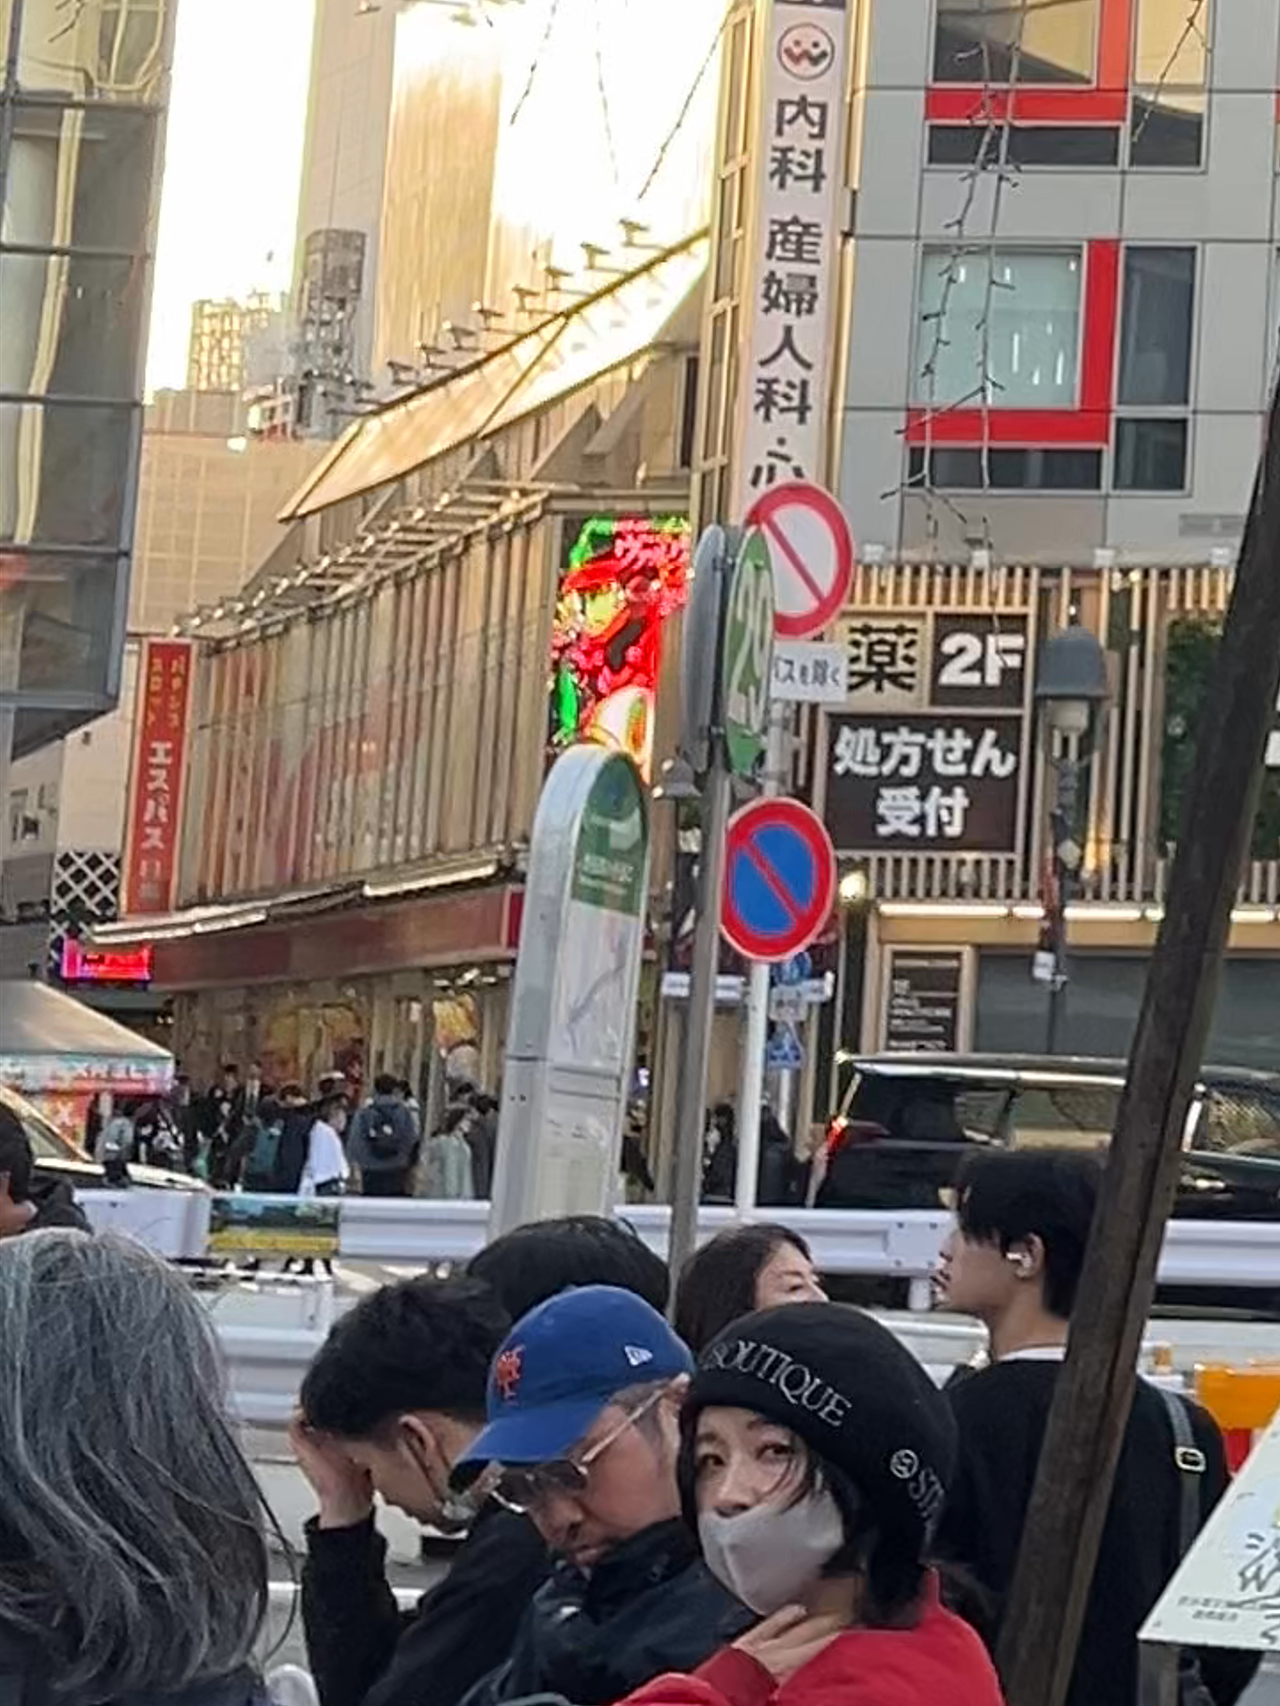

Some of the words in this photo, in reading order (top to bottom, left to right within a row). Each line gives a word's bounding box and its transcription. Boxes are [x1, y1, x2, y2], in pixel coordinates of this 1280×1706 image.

[768, 93, 829, 193] 内科
[848, 623, 919, 693] 薬
[938, 632, 1026, 686] 2F
[833, 723, 1017, 778] 処方せん
[875, 785, 970, 837] 受付
